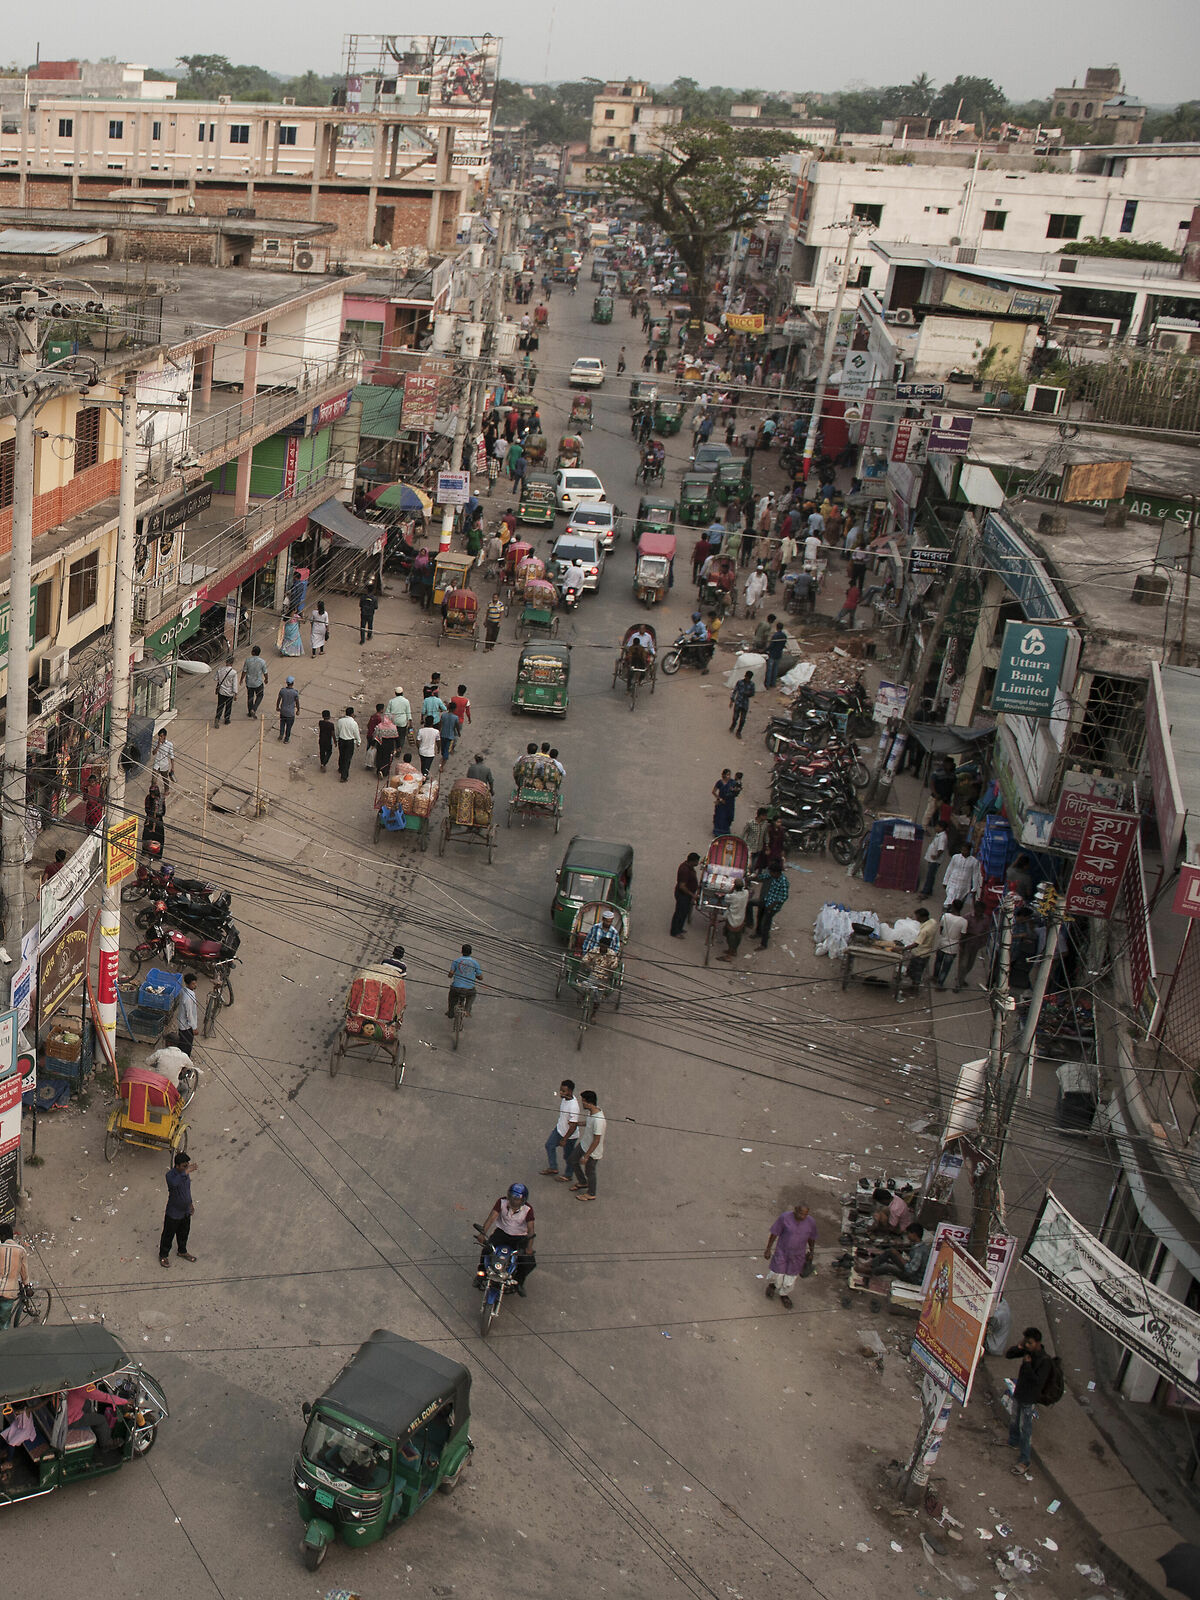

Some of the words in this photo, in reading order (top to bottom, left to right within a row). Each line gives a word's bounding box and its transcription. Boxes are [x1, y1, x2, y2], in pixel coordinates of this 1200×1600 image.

[408, 375, 438, 388] শাহ
[160, 617, 190, 645] oppo
[1010, 656, 1050, 670] Uttara
[1011, 670, 1044, 683] Bank
[1000, 682, 1049, 697] Limited
[1029, 700, 1049, 708] Branch
[1075, 870, 1118, 887] টেইলার্স
